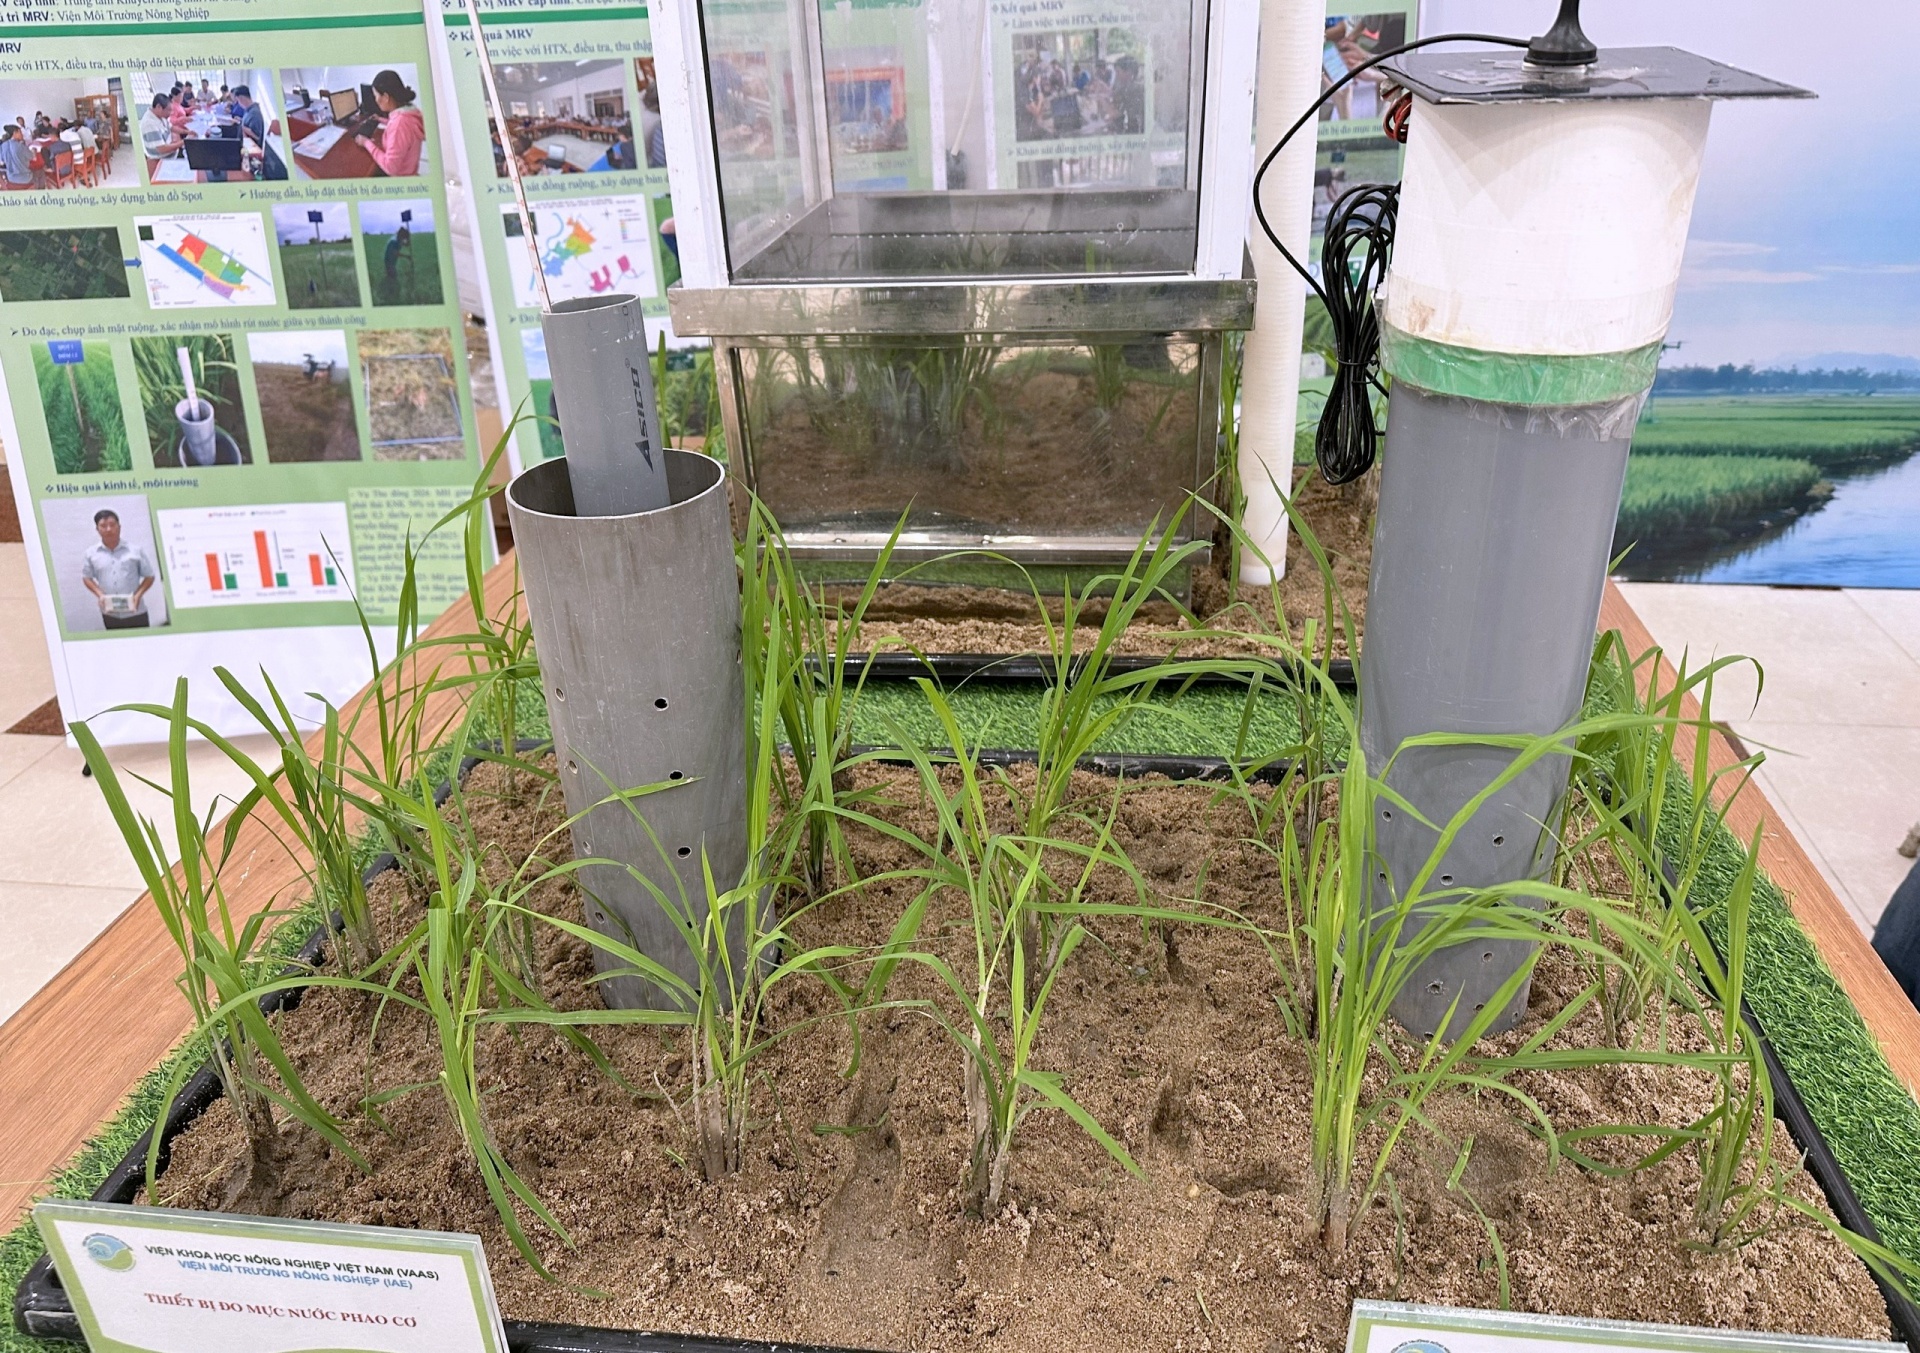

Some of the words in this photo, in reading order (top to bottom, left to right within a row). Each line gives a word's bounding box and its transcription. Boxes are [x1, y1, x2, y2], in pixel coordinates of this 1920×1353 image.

[57, 10, 81, 22] Viện
[84, 10, 104, 20] Môi
[108, 10, 143, 22] Trường
[146, 8, 172, 20] Nông
[175, 8, 210, 21] Nghiệp
[506, 28, 534, 40] MRV
[502, 44, 522, 57] việc
[544, 44, 570, 56] HTX,
[16, 60, 32, 70] với
[35, 60, 64, 71] HTX,
[66, 56, 87, 70] điều
[90, 60, 106, 70] tra,
[108, 58, 124, 68] thu
[126, 58, 148, 70] thập
[150, 57, 162, 68] dữ
[165, 56, 182, 68] liệu
[186, 56, 204, 68] phát
[208, 55, 226, 66] thải
[228, 56, 240, 65] cơ
[243, 54, 254, 64] sở
[24, 197, 37, 206] sát
[40, 193, 64, 208] đồng
[67, 196, 99, 208] ruộng,
[101, 192, 117, 204] xây
[120, 192, 145, 204] dựng
[182, 191, 203, 203] Spot
[22, 326, 36, 336] Đo
[40, 326, 59, 338] đạc,
[62, 325, 85, 338] chụp
[104, 480, 126, 490] kinh
[144, 1245, 174, 1256] VIỆN
[176, 1248, 212, 1260] KHOA
[214, 1252, 241, 1264] HỌC
[244, 1254, 281, 1266] NÔNG
[284, 1258, 330, 1271] NGHIỆP
[333, 1262, 361, 1274] VIỆT
[365, 1265, 394, 1276] NAM
[396, 1268, 440, 1280] (VAAS)
[178, 1260, 206, 1271] VIỆN
[208, 1262, 232, 1272] MÔI
[234, 1265, 290, 1278] TRƯỜNG
[294, 1270, 330, 1282] NÔNG
[333, 1274, 380, 1287] NGHIỆP
[384, 1278, 412, 1290] (IAE)
[144, 1292, 194, 1307] THIẾT
[198, 1300, 216, 1312] BỊ
[218, 1301, 244, 1312] ĐO
[246, 1304, 285, 1318] MỰC
[288, 1308, 336, 1321] NƯỚC
[341, 1312, 388, 1325] PHAO
[392, 1316, 417, 1328] CƠ
